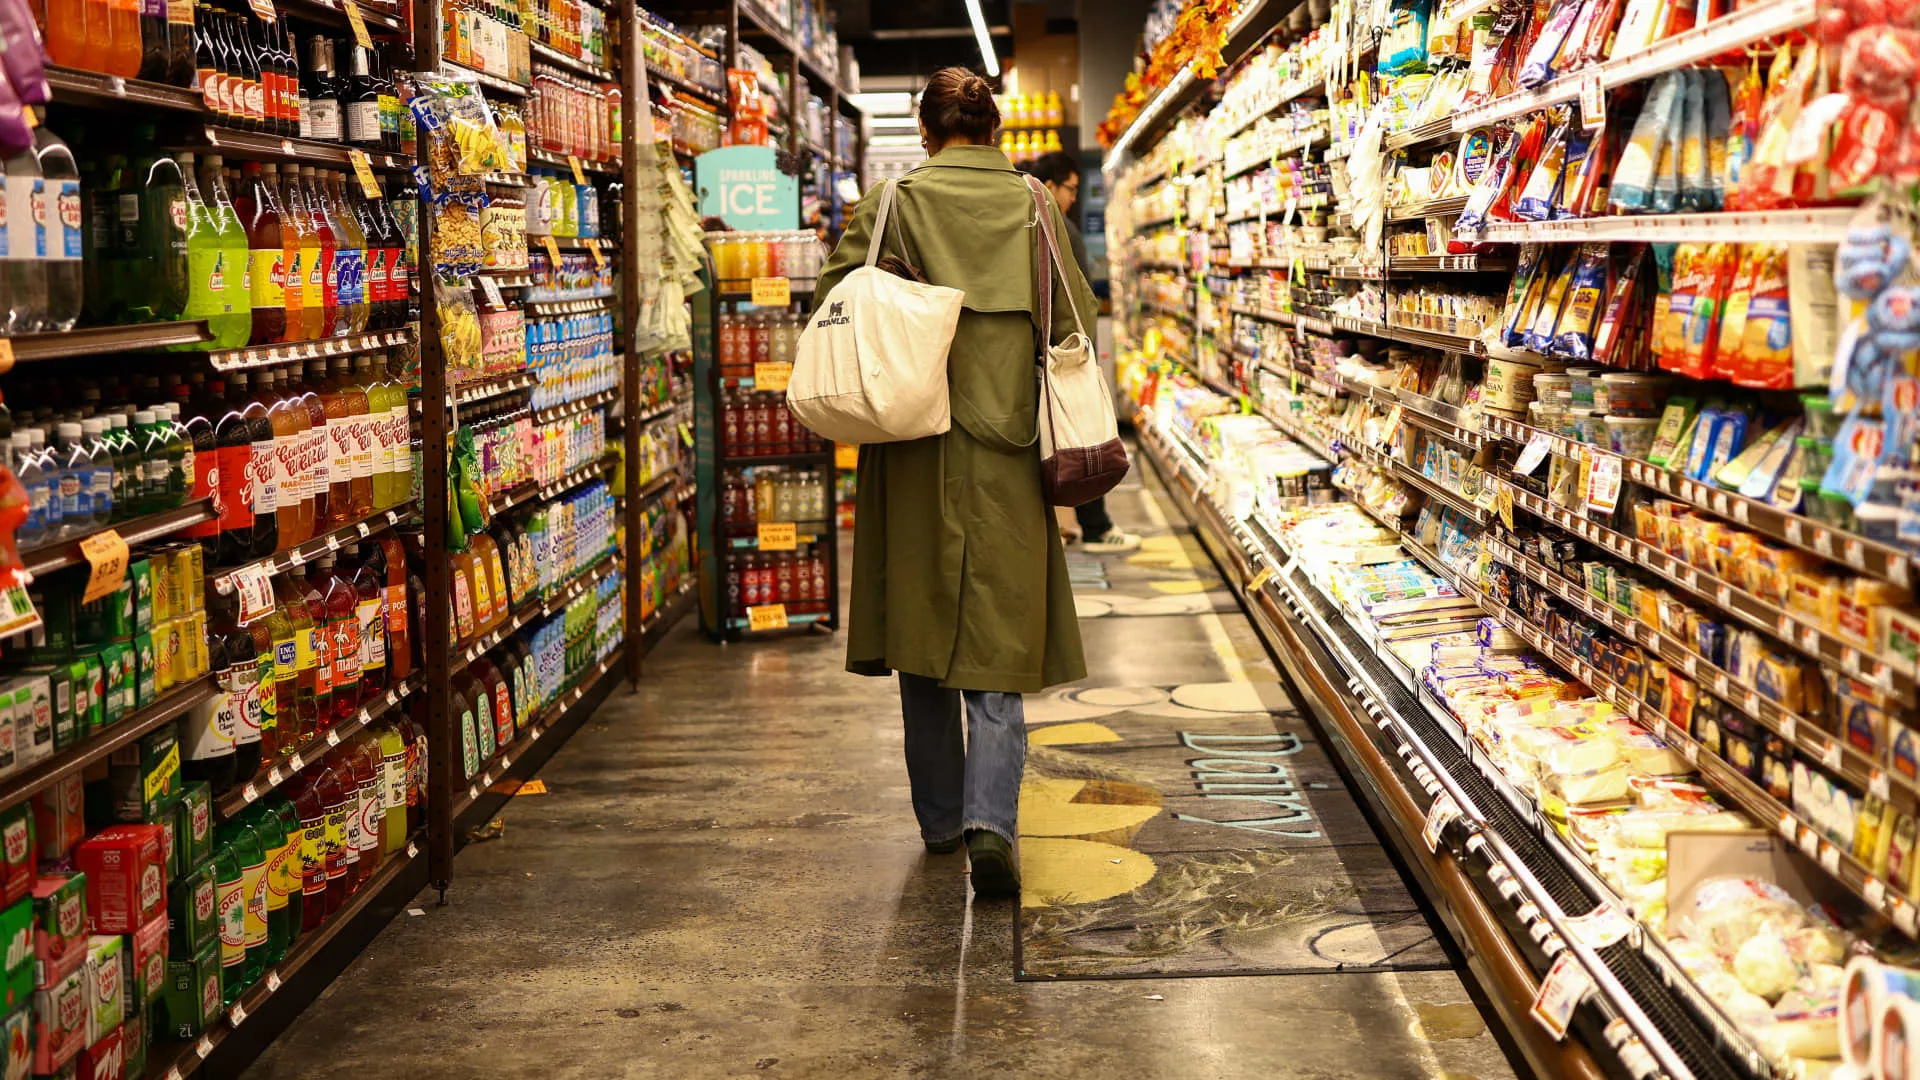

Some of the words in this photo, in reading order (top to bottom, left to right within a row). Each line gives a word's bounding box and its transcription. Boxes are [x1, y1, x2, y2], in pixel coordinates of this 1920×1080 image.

[720, 169, 776, 182] SPARKLING
[720, 184, 781, 215] ICE
[817, 316, 850, 329] STANLEY
